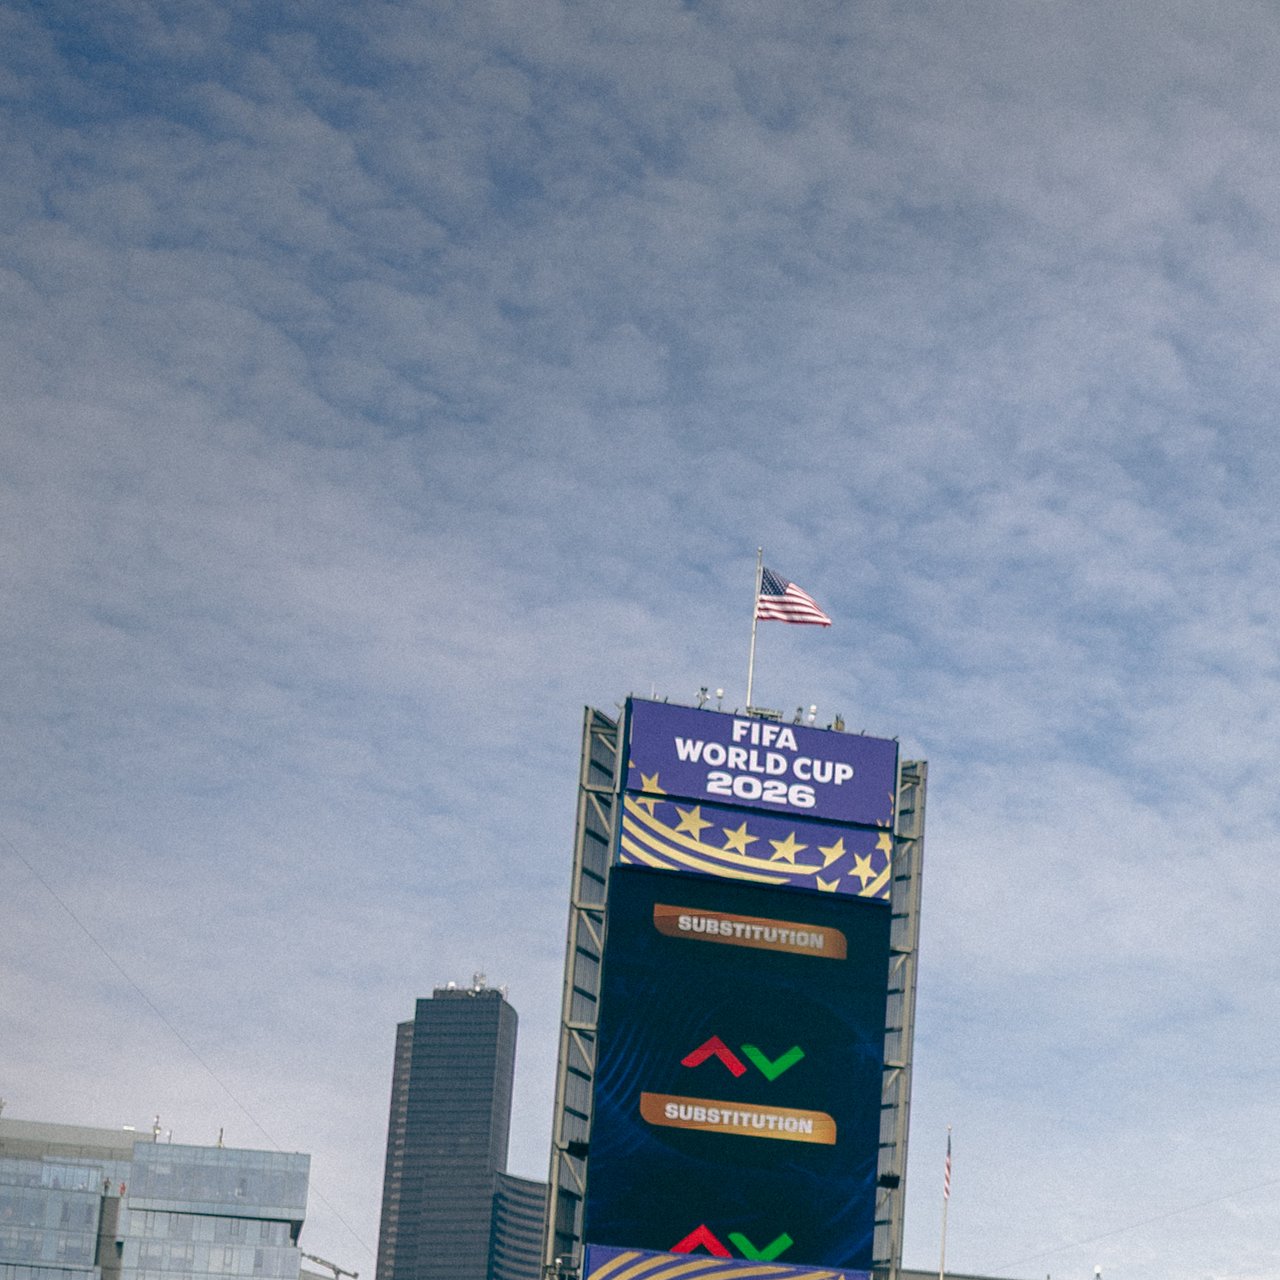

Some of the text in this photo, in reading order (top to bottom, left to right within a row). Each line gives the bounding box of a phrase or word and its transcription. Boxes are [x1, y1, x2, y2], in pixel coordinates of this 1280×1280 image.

[732, 720, 798, 751] FIFA
[675, 737, 854, 785] WORLD CUP
[706, 771, 816, 809] 2026
[678, 915, 824, 949] SUBSTITUTION
[664, 1103, 813, 1134] SUBSTITUTION
